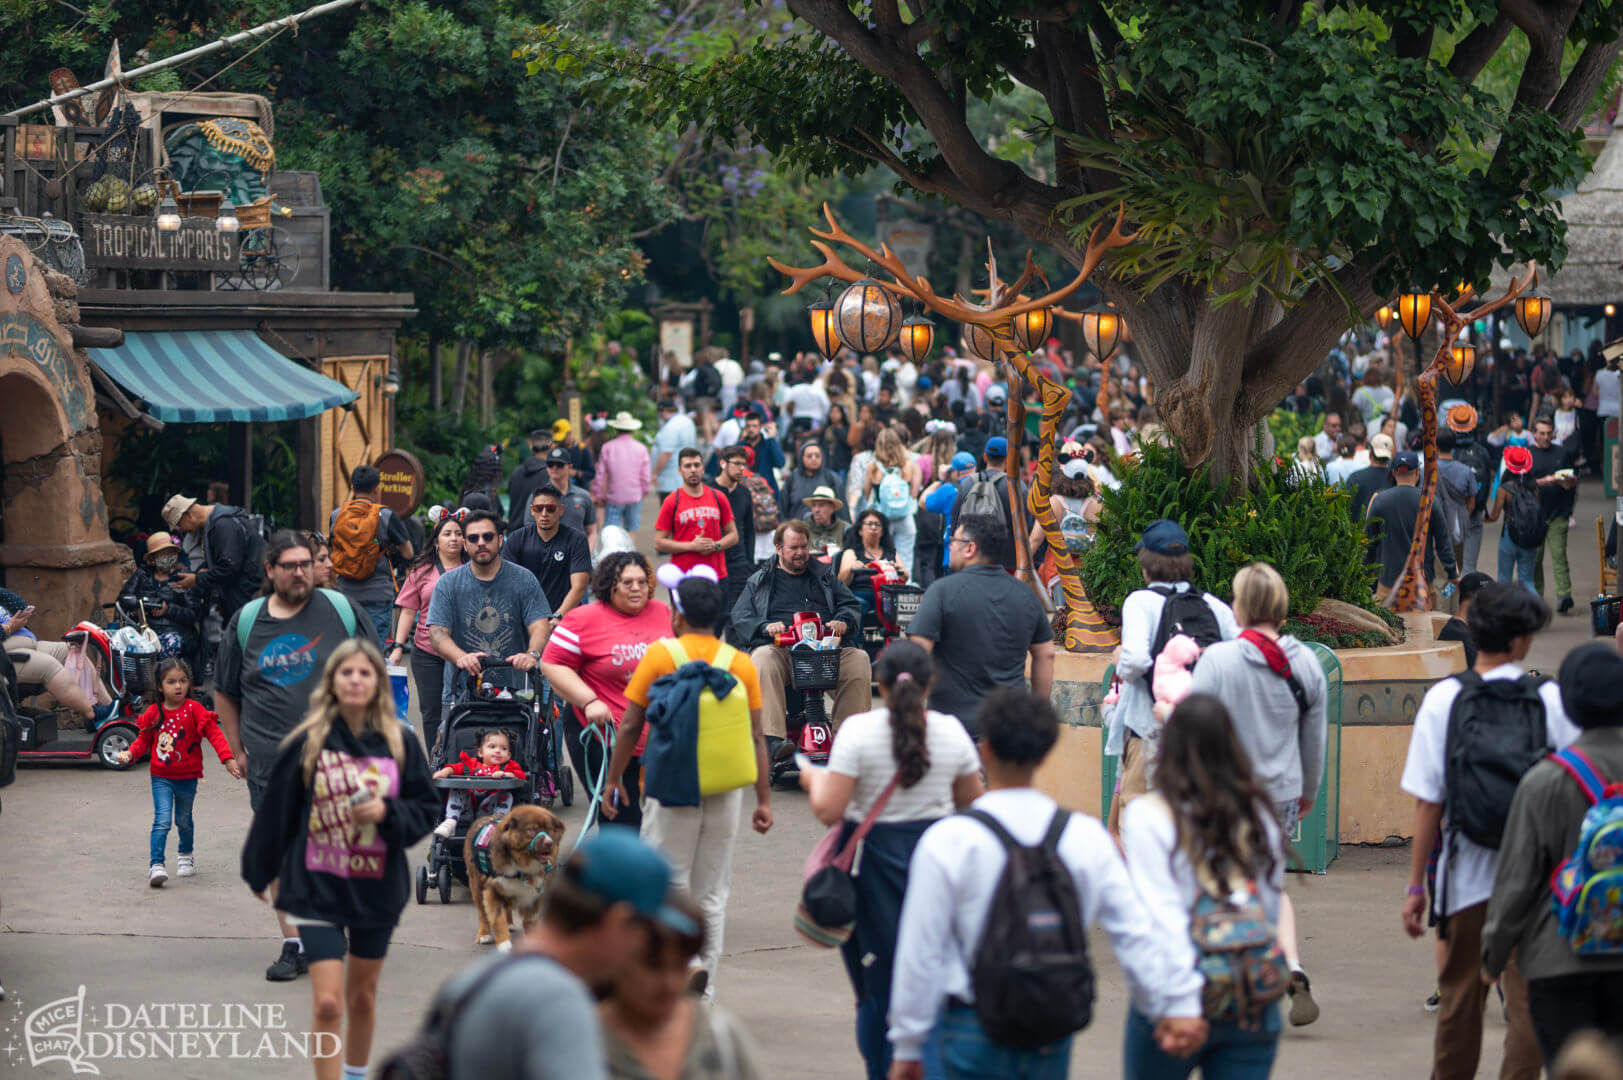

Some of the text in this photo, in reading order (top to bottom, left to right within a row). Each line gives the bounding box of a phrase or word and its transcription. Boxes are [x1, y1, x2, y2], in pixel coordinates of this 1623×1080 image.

[93, 223, 232, 261] TROPICAL IMPORTS
[379, 471, 412, 482] Stroller
[379, 482, 413, 496] Parking
[263, 650, 314, 668] NASA
